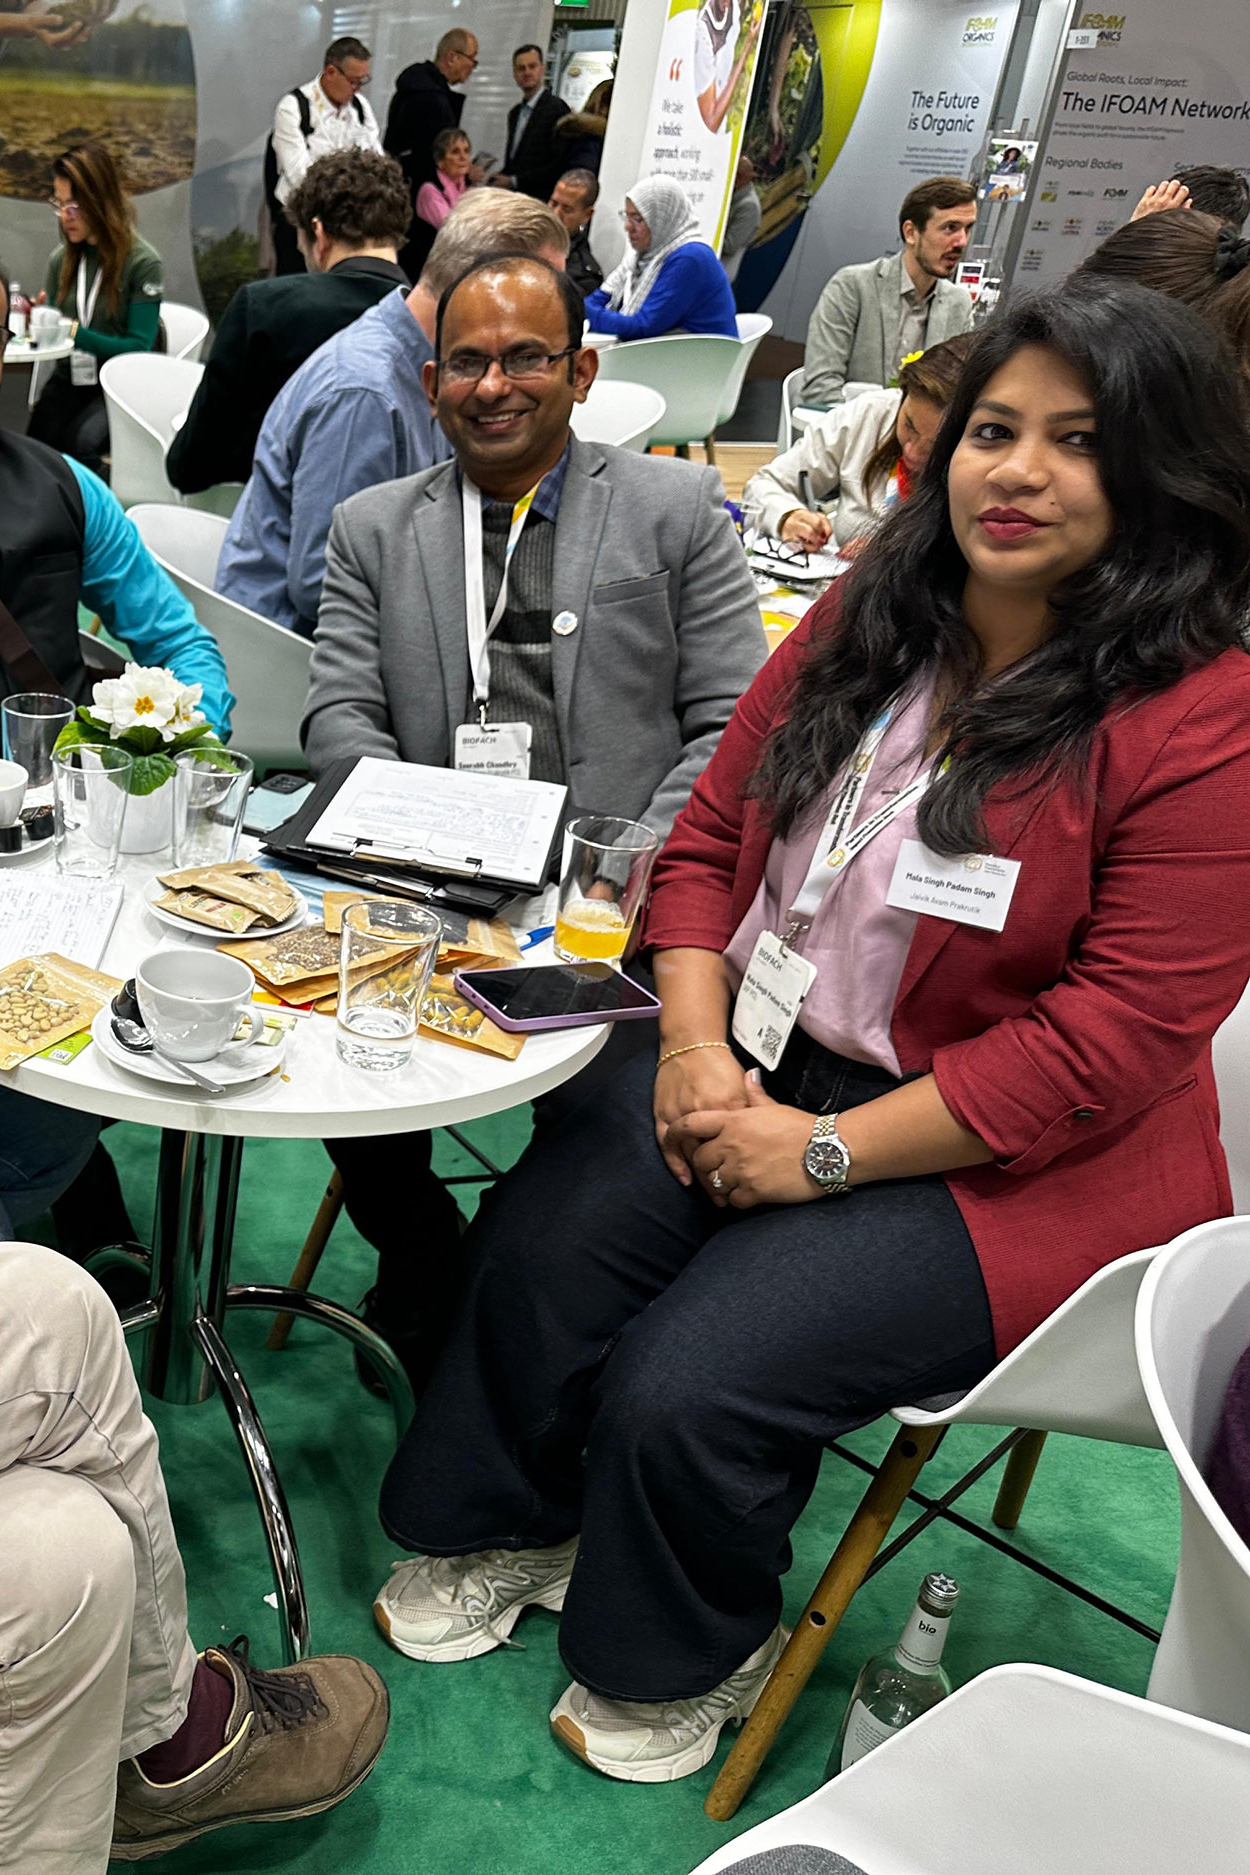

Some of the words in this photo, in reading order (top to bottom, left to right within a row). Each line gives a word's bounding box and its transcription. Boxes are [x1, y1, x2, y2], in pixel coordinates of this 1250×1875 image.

[963, 32, 995, 43] ORGANICS
[1066, 71, 1097, 83] Global
[1098, 72, 1126, 86] Roots,
[1128, 75, 1153, 86] Local
[1154, 76, 1189, 89] Impact:
[911, 91, 934, 109] The
[936, 91, 980, 110] Future
[1062, 91, 1096, 113] The
[1100, 94, 1168, 116] IFOAM
[1171, 99, 1250, 120] Network
[908, 113, 919, 130] is
[921, 113, 975, 136] Organic
[1045, 156, 1088, 170] Regional
[1090, 158, 1124, 170] Bodies
[462, 736, 497, 745] BIOFACH
[905, 872, 923, 883] Mala
[924, 876, 945, 888] Singh
[946, 882, 973, 894] Padam
[973, 887, 996, 899] Singh
[758, 947, 783, 972] BIOFACH
[918, 1620, 937, 1634] bio
